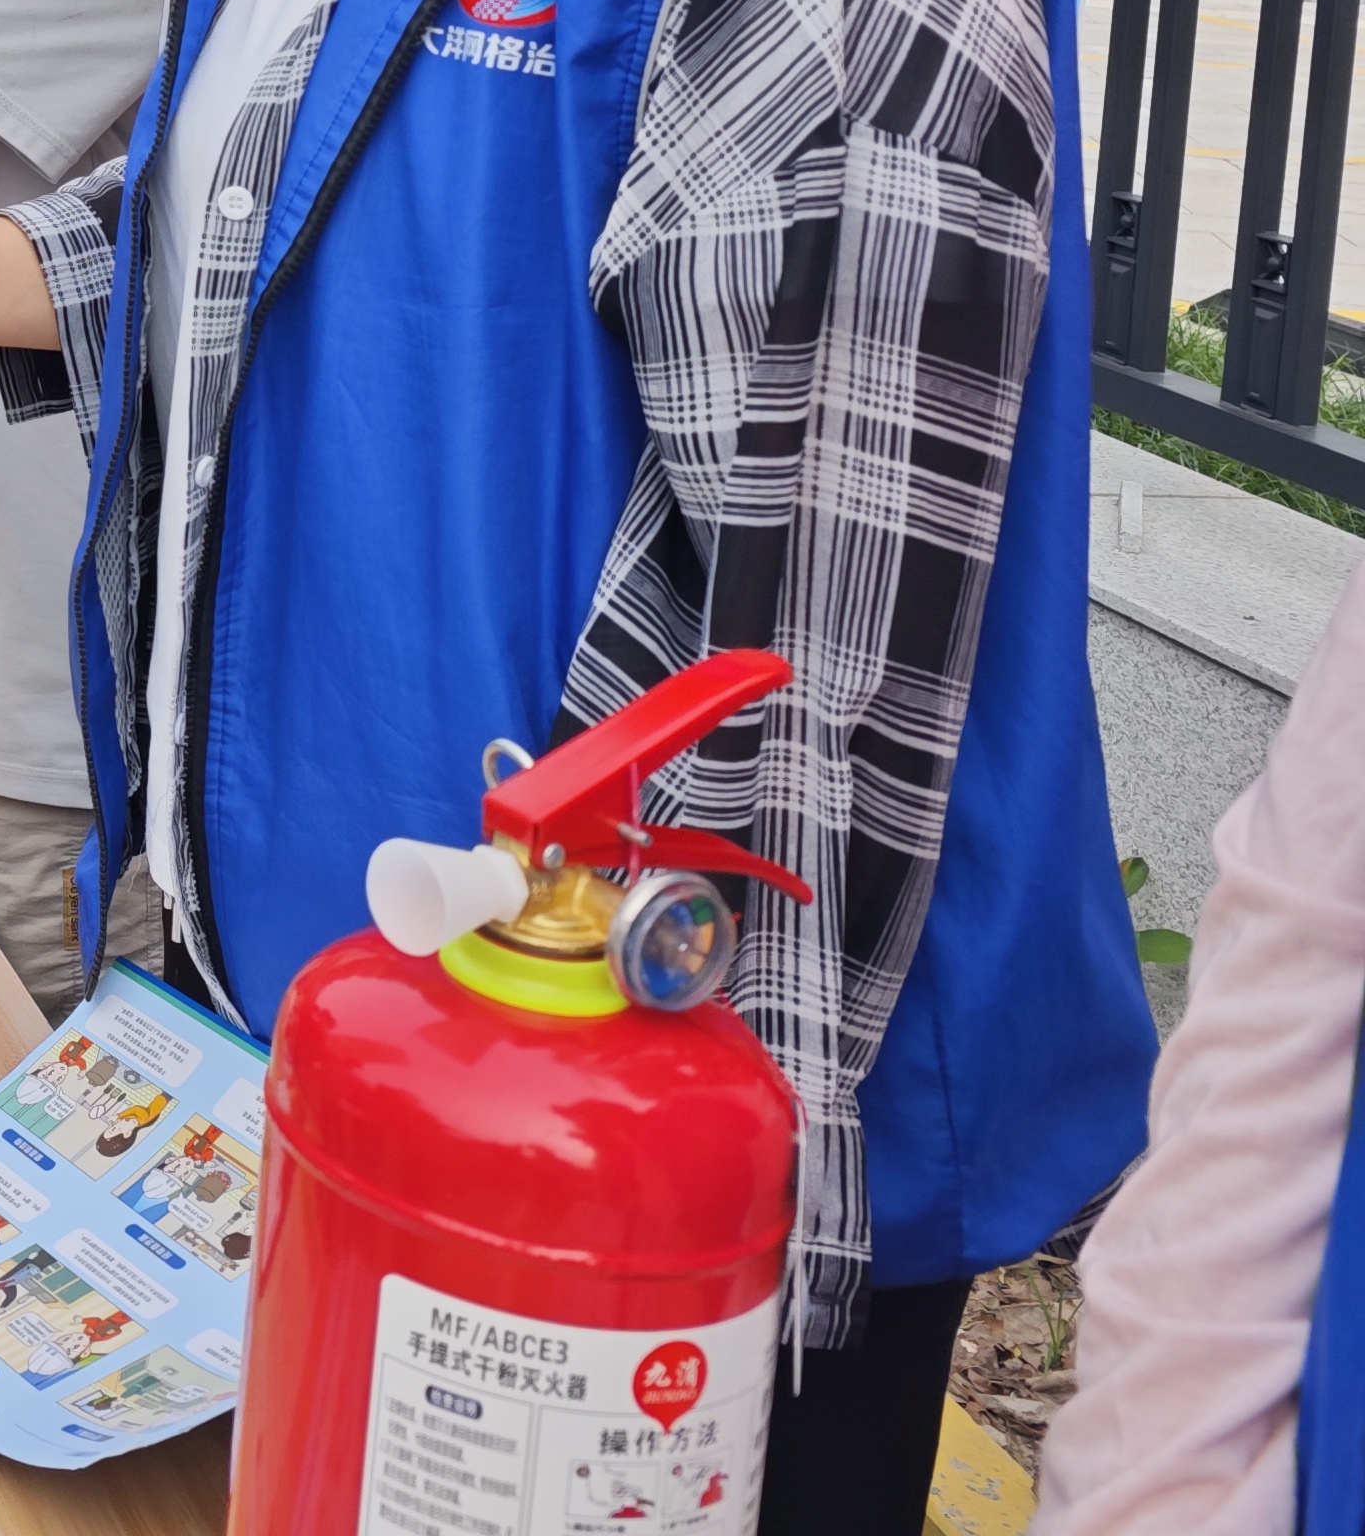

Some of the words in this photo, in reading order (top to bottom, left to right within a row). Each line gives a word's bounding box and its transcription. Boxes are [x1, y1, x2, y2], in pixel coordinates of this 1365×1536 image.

[408, 1330, 587, 1402] 手提式干粉灭火器
[430, 1307, 569, 1366] MF/ABCE3
[599, 1421, 718, 1456] 操作方法
